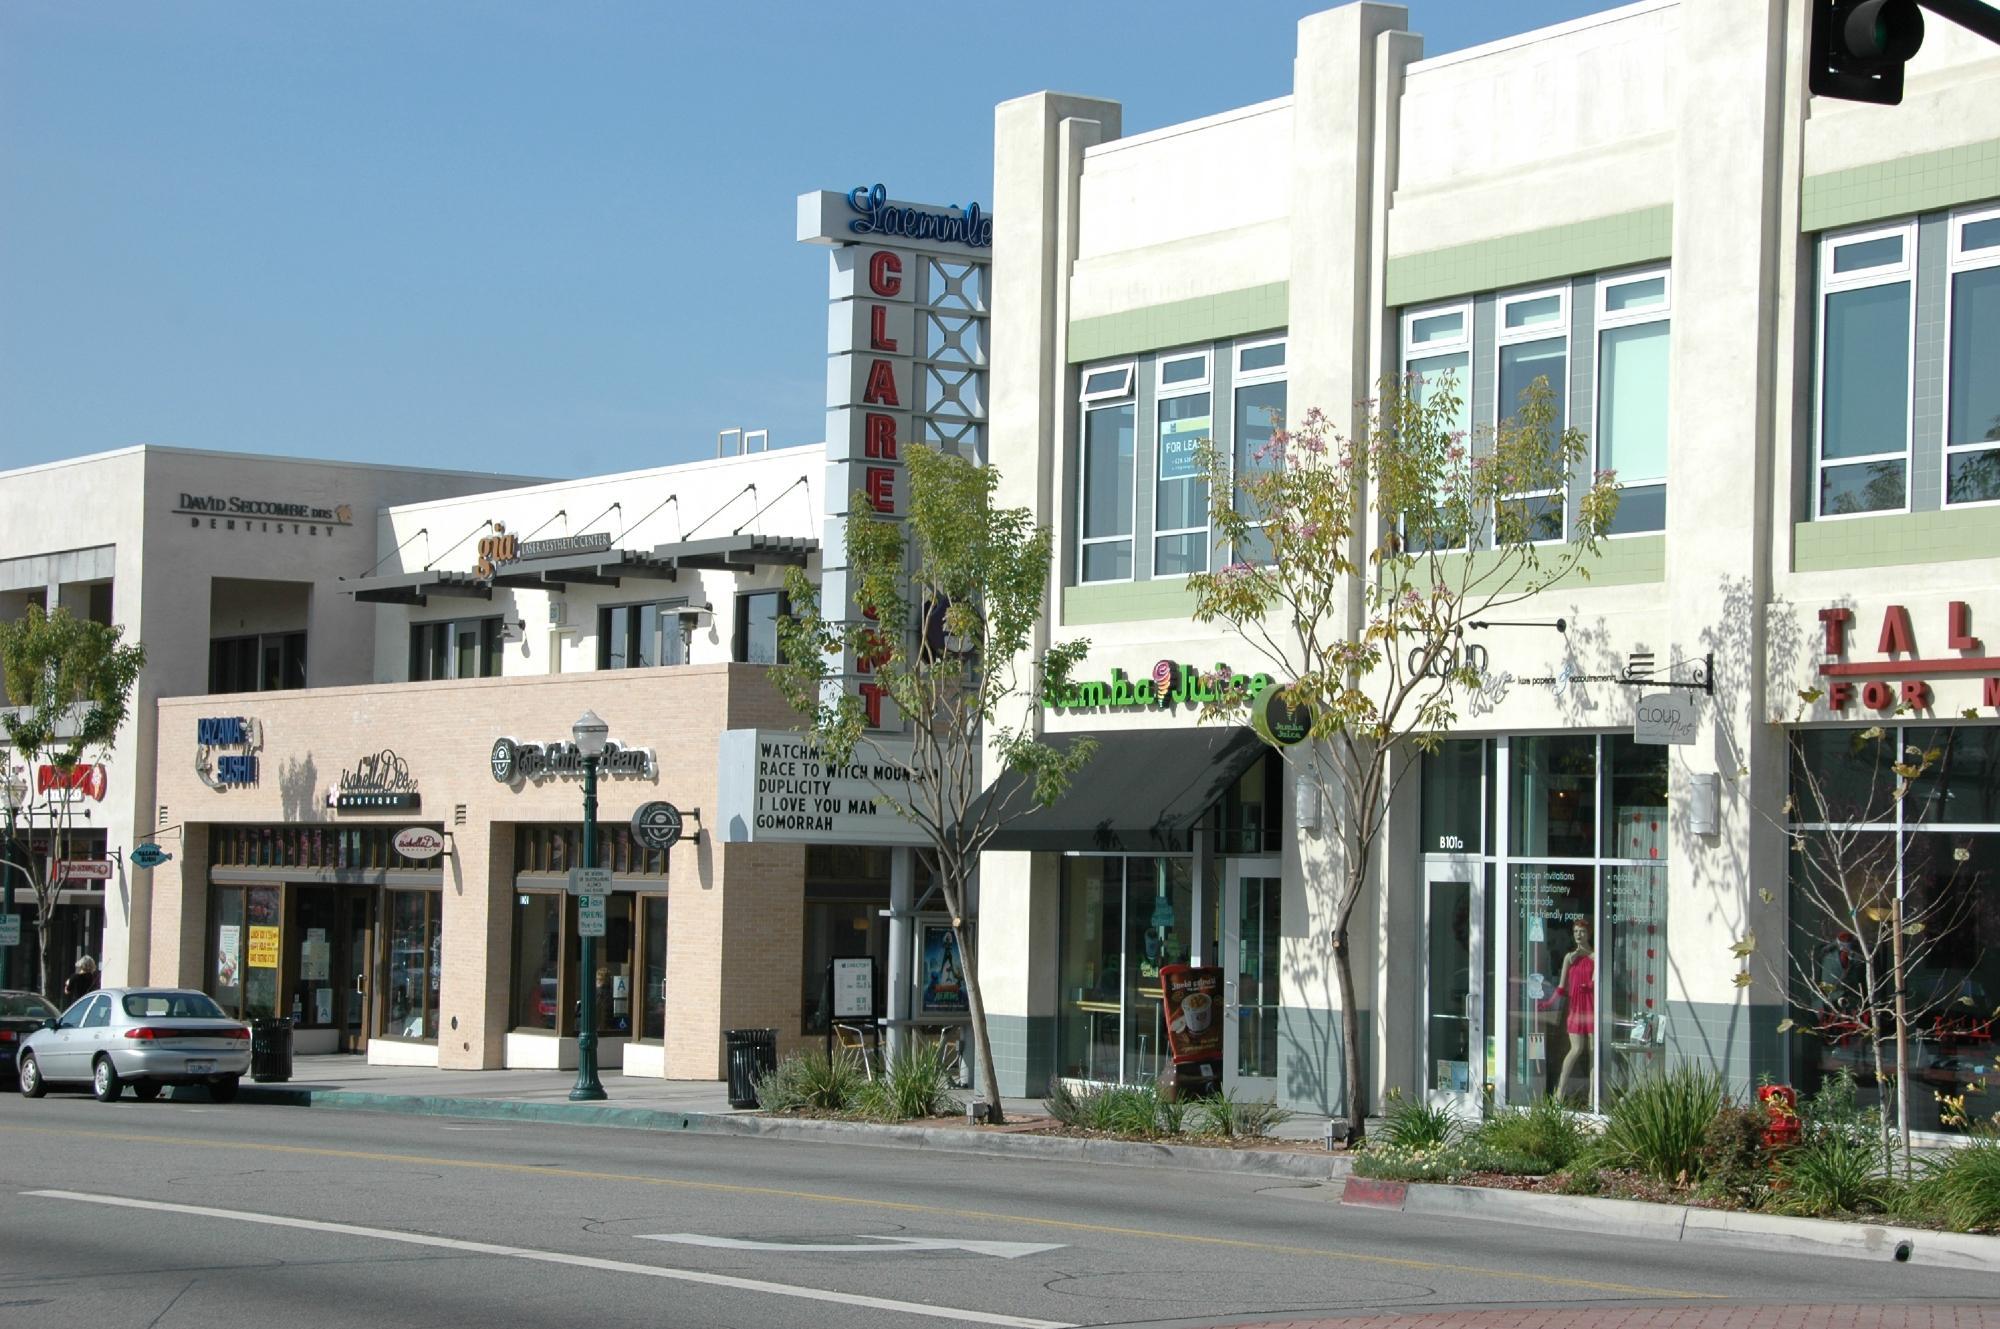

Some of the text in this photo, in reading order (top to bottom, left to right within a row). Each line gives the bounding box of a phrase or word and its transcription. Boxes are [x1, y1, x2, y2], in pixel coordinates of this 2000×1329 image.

[848, 183, 992, 248] Laemmle
[1166, 441, 1181, 453] FOR
[180, 493, 333, 519] DAVID SECCOMBE DDS
[191, 518, 333, 537] DENTISTRY
[521, 534, 608, 555] LASER AESTHETIC CENTER
[1830, 680, 1927, 711] FOR
[1638, 708, 1680, 723] CLOUD
[199, 718, 245, 745] KAZAMA
[598, 742, 642, 771] Bean
[217, 756, 256, 784] SUSHI
[760, 762, 795, 777] RACE
[803, 763, 819, 777] TO
[826, 764, 867, 780] WITCH
[759, 779, 831, 795] DUPLICITY
[342, 796, 398, 806] BOUTIQUE
[759, 797, 876, 815] I LOVE YOU MAN
[757, 814, 832, 831] GOMORRAH
[1439, 836, 1463, 849] B101a
[1543, 871, 1575, 881] invitations
[1540, 885, 1570, 896] stationery
[581, 897, 589, 907] 2
[1565, 912, 1585, 923] paper
[618, 980, 625, 991] A
[321, 1007, 329, 1018] A
